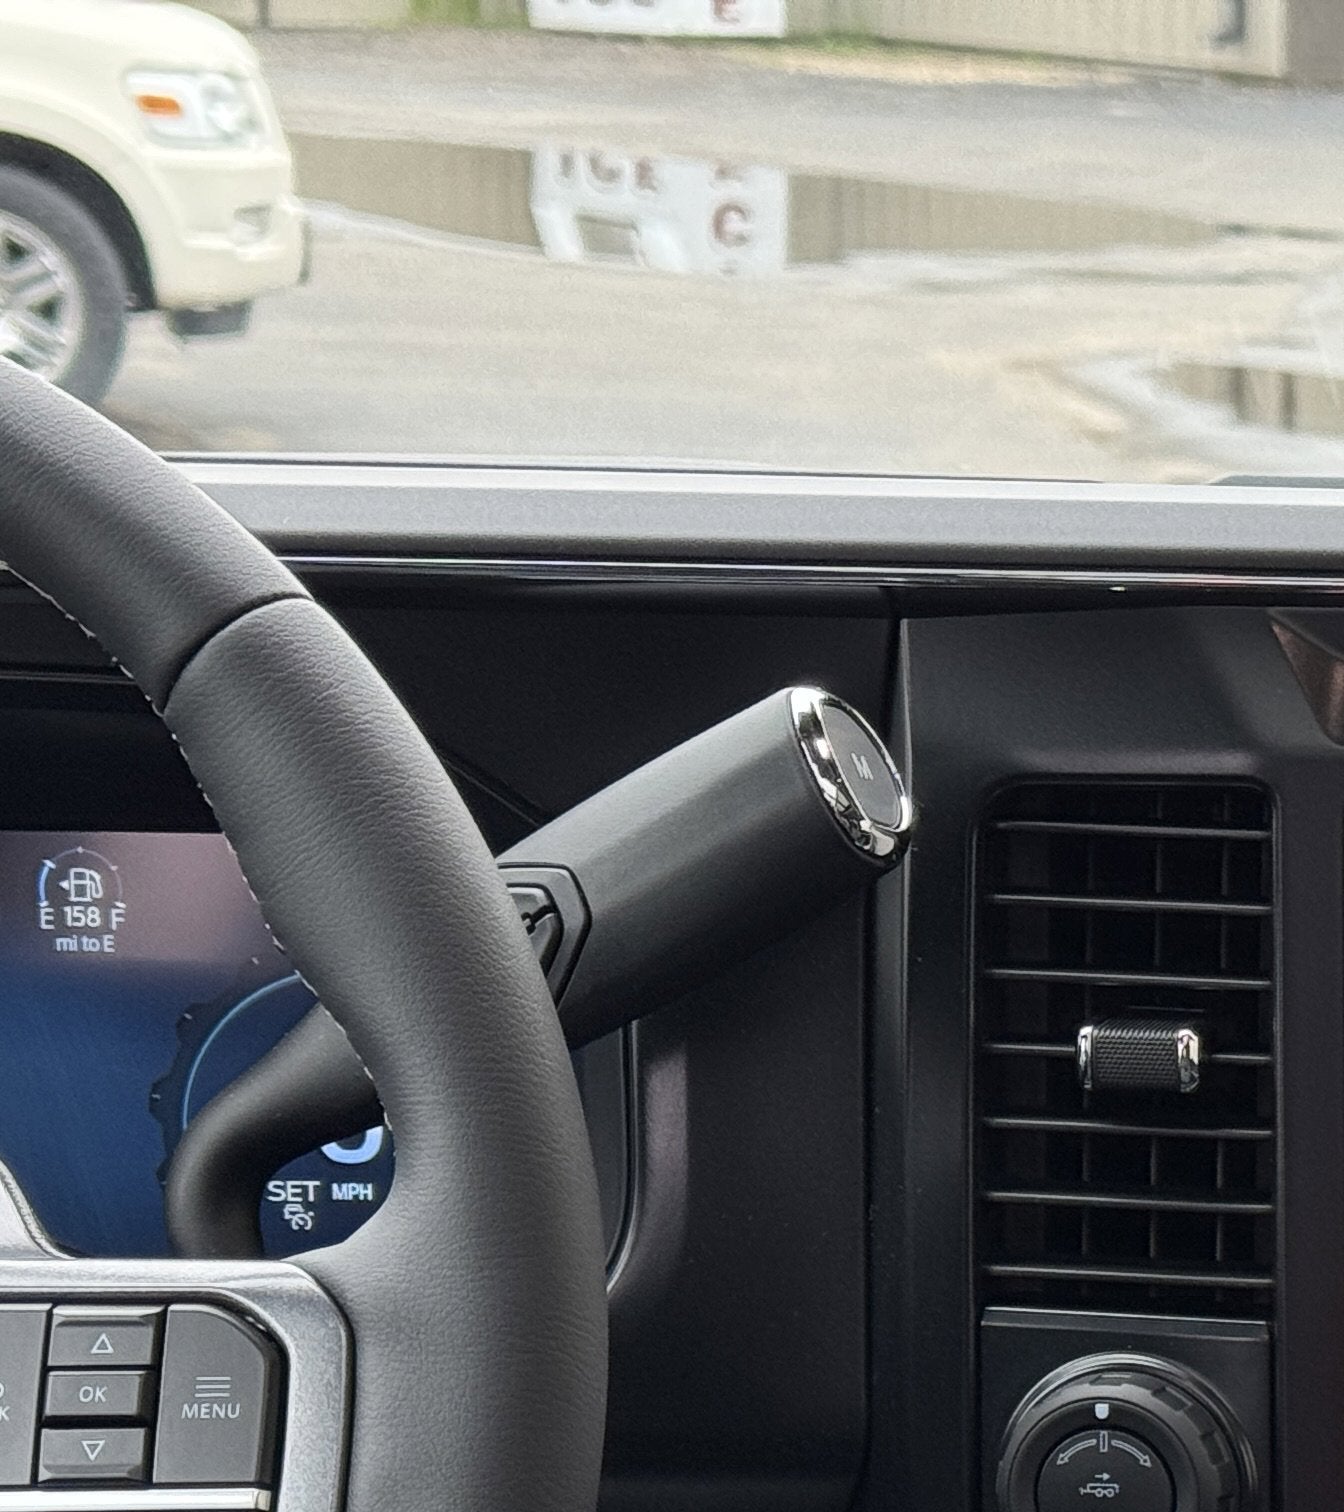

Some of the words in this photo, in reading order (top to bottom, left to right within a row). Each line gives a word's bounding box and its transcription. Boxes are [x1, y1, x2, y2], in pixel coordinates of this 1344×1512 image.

[40, 907, 56, 930] E
[63, 905, 102, 928] 158
[110, 908, 127, 931] F
[55, 934, 79, 952] mi
[80, 935, 101, 952] to
[102, 934, 116, 953] E
[267, 1180, 321, 1203] SET
[331, 1182, 374, 1201] MPH
[79, 1385, 108, 1403] OK
[181, 1402, 241, 1419] MENU
